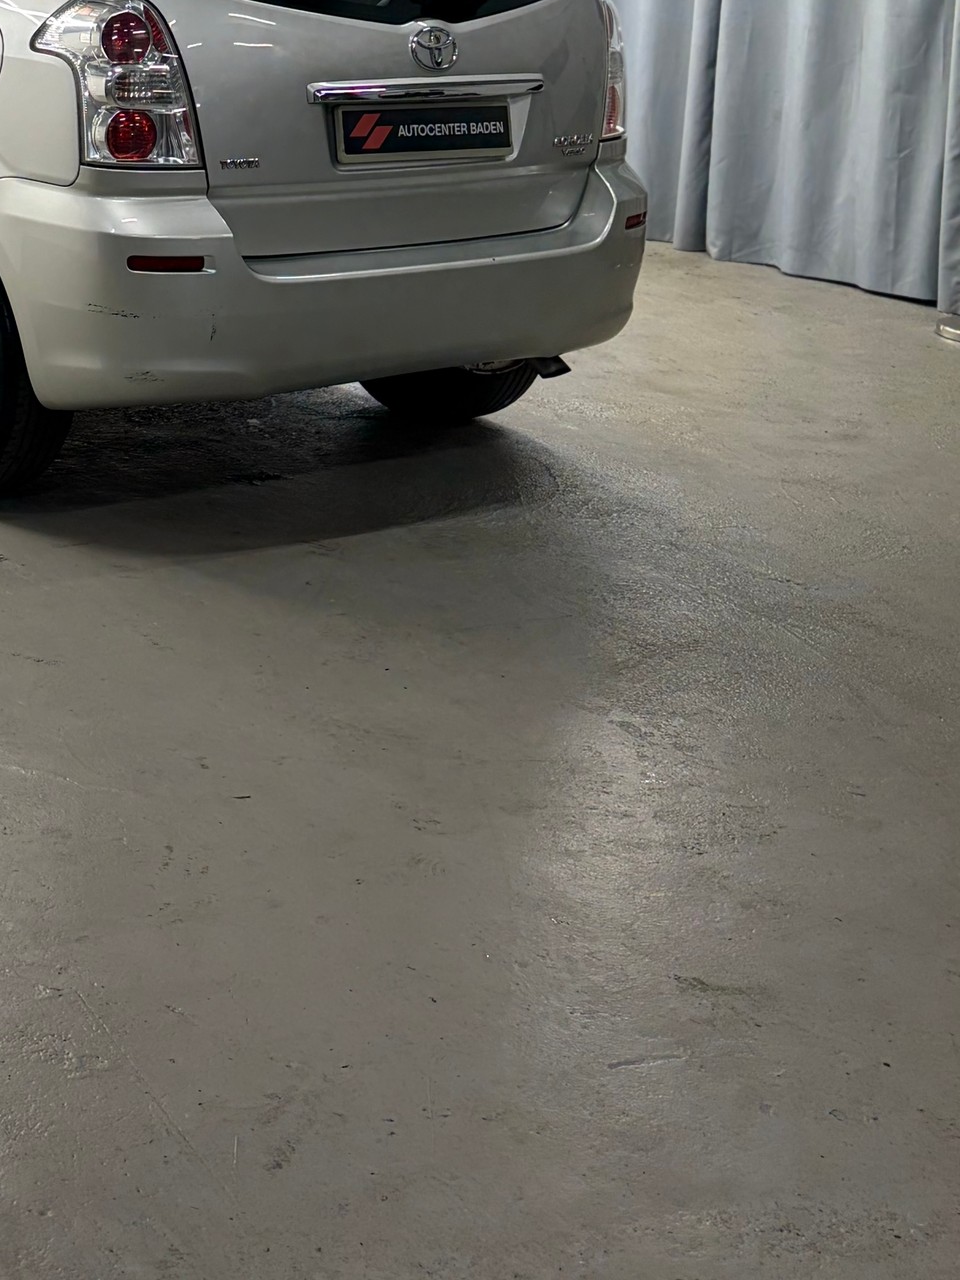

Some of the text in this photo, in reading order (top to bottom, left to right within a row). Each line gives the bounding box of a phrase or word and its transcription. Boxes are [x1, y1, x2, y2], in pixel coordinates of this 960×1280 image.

[398, 121, 504, 137] AUTOCENTER BADEN
[220, 157, 260, 170] TOYOTA
